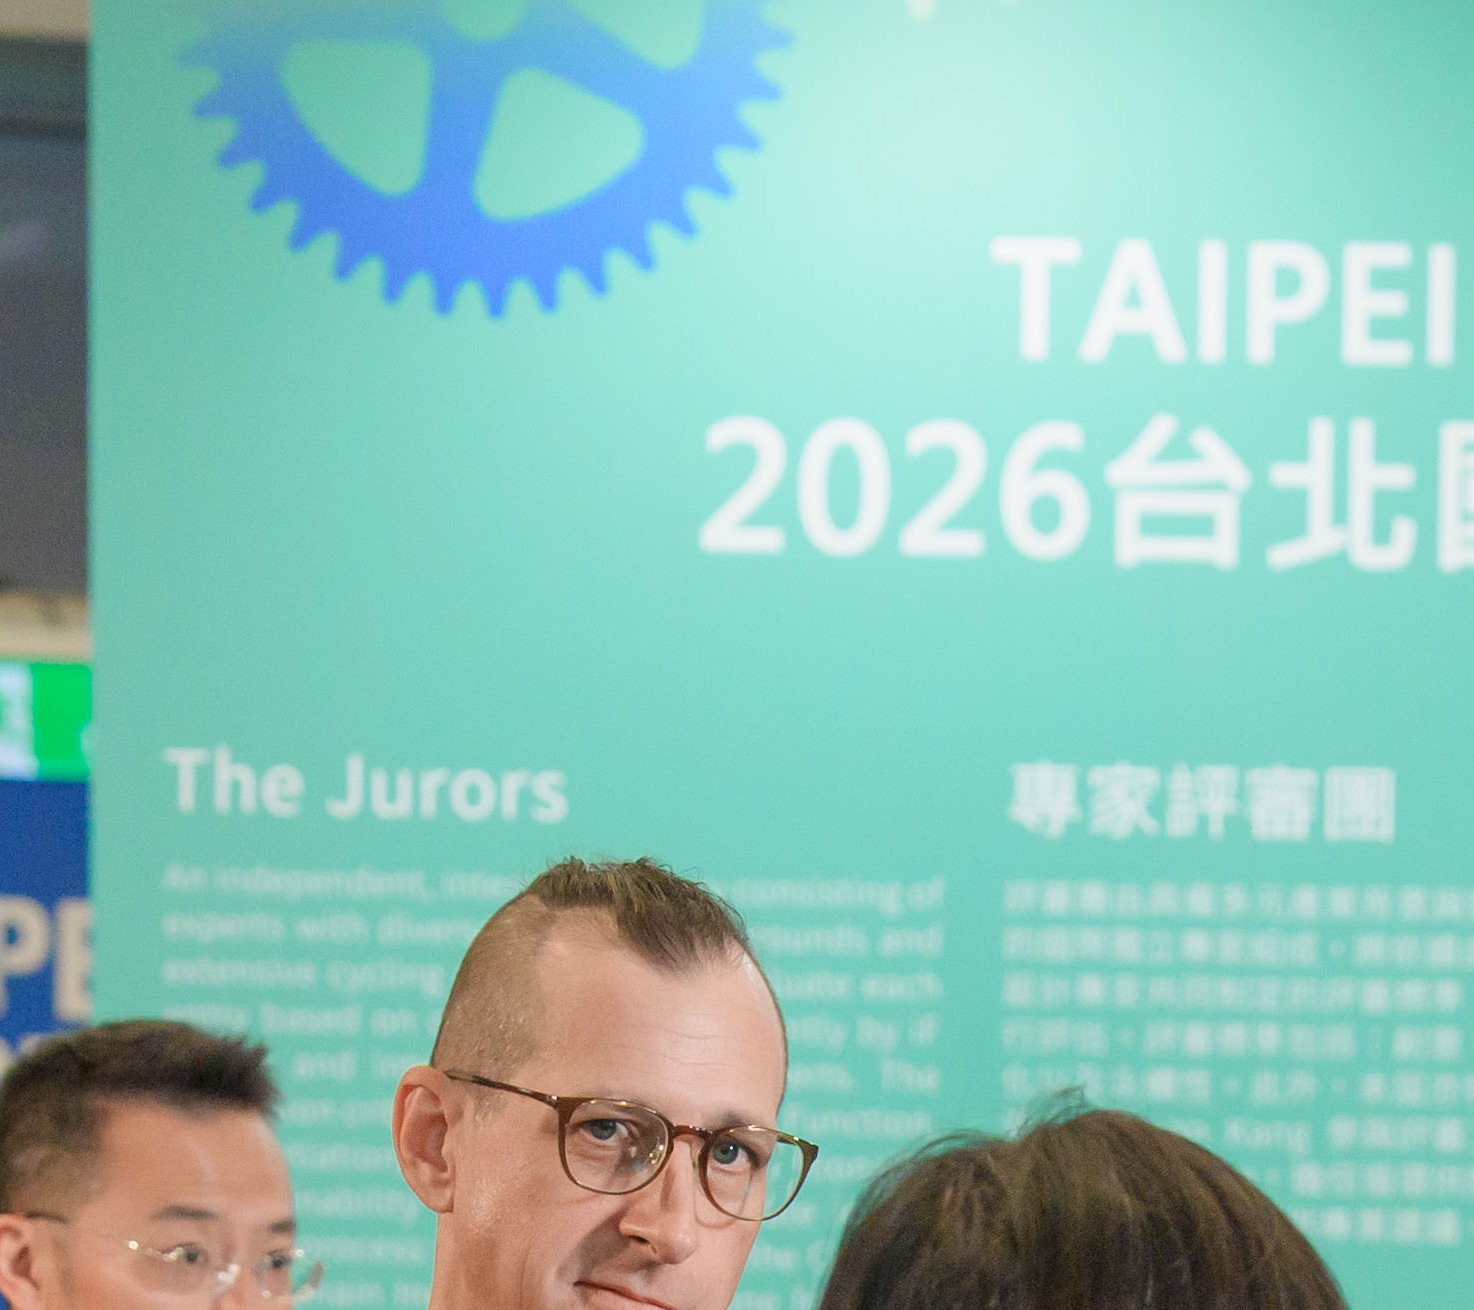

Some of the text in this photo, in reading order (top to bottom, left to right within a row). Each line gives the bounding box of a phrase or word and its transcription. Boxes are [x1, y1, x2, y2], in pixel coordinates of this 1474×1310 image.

[988, 234, 1456, 367] TAIPEI
[163, 744, 569, 823] The Jurors
[1007, 759, 1396, 842] 專家評審團
